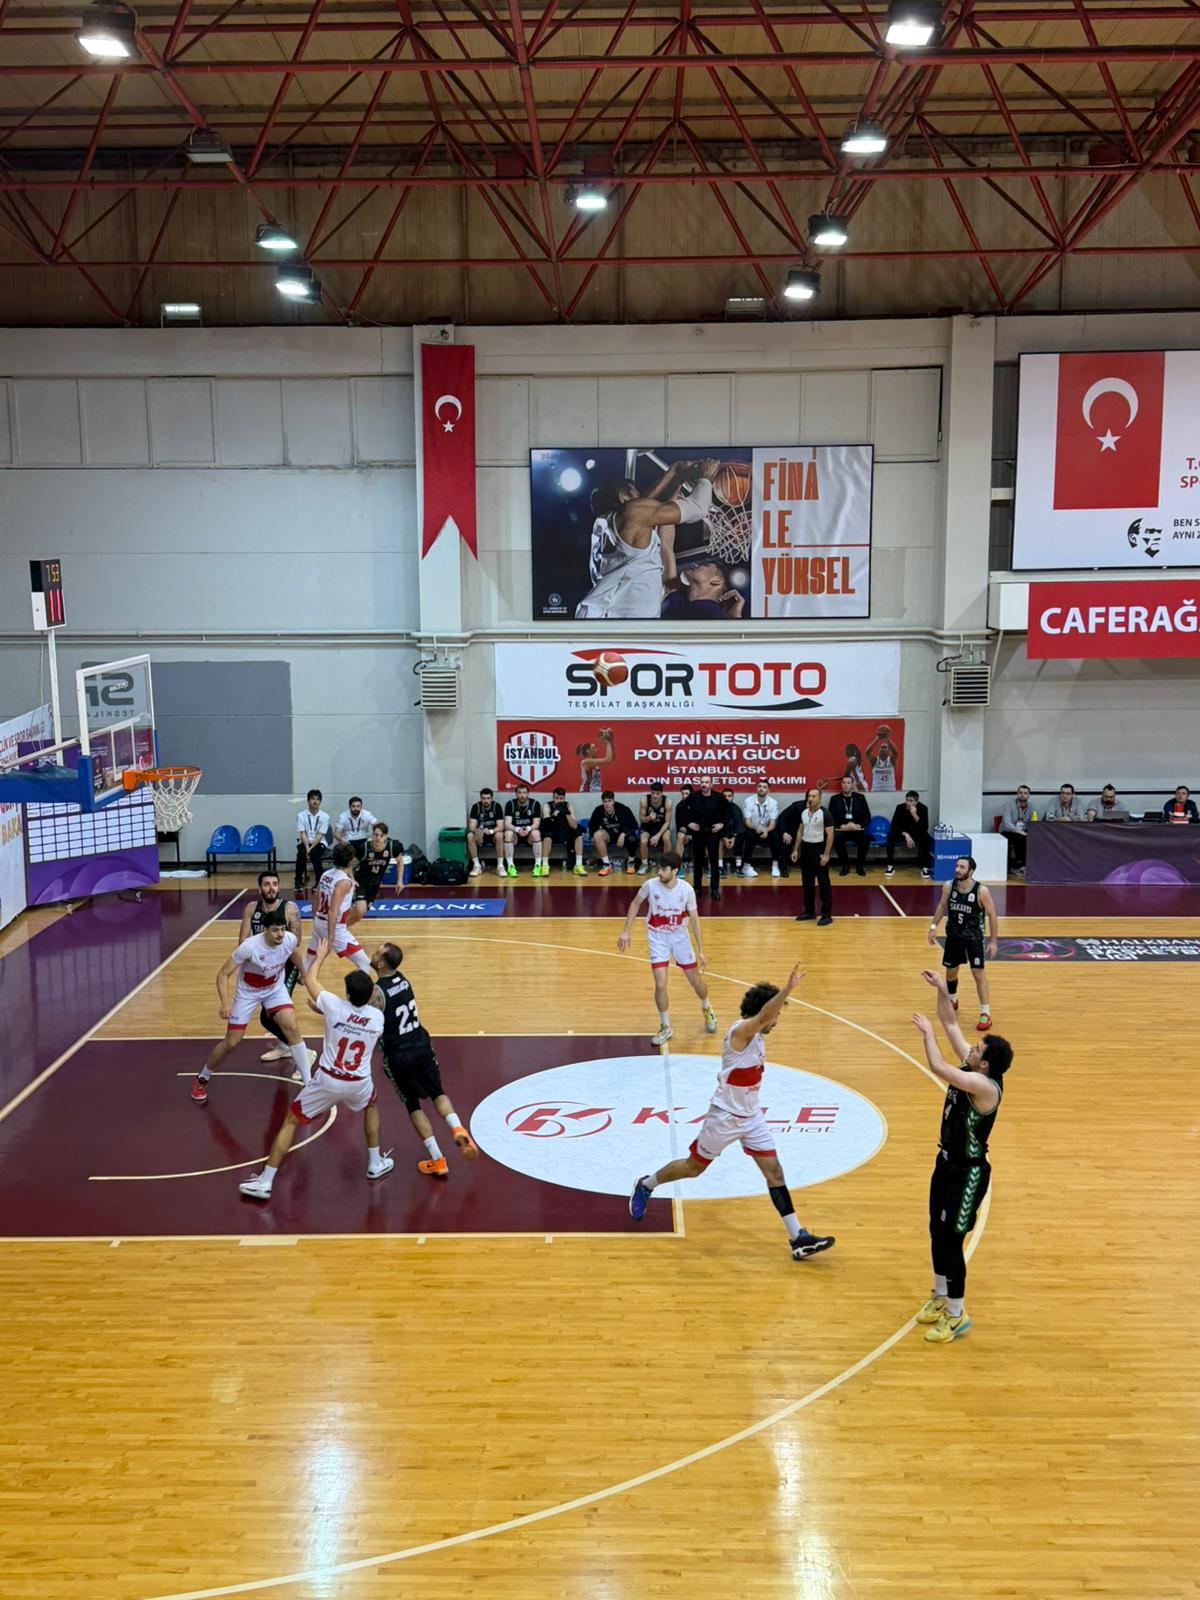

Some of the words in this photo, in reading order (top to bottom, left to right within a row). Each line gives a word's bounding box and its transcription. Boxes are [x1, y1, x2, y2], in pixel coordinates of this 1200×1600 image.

[1185, 457, 1200, 471] T.
[1180, 475, 1200, 488] SP
[762, 510, 792, 549] LE
[1173, 518, 1192, 527] BEN
[1172, 530, 1195, 539] AYNI
[761, 554, 855, 595] YÜKSEL
[1040, 598, 1200, 635] CAFERAĞ
[568, 700, 620, 708] TEŞKİLAT
[627, 700, 695, 708] BAŞKANLIĞI
[654, 731, 701, 745] YENİ
[706, 731, 780, 745] NESLİN
[506, 744, 559, 760] İSTANBUL
[633, 747, 737, 761] POTADAKİ
[742, 746, 800, 761] GÜCÜ
[667, 765, 734, 774] İSTANBUL
[738, 766, 766, 774] GSK
[627, 776, 670, 785] KADIN
[673, 776, 756, 785] BASETBOL
[369, 902, 486, 911] LKBANK
[957, 913, 964, 925] 5
[395, 999, 419, 1036] 23
[333, 1036, 366, 1072] 13
